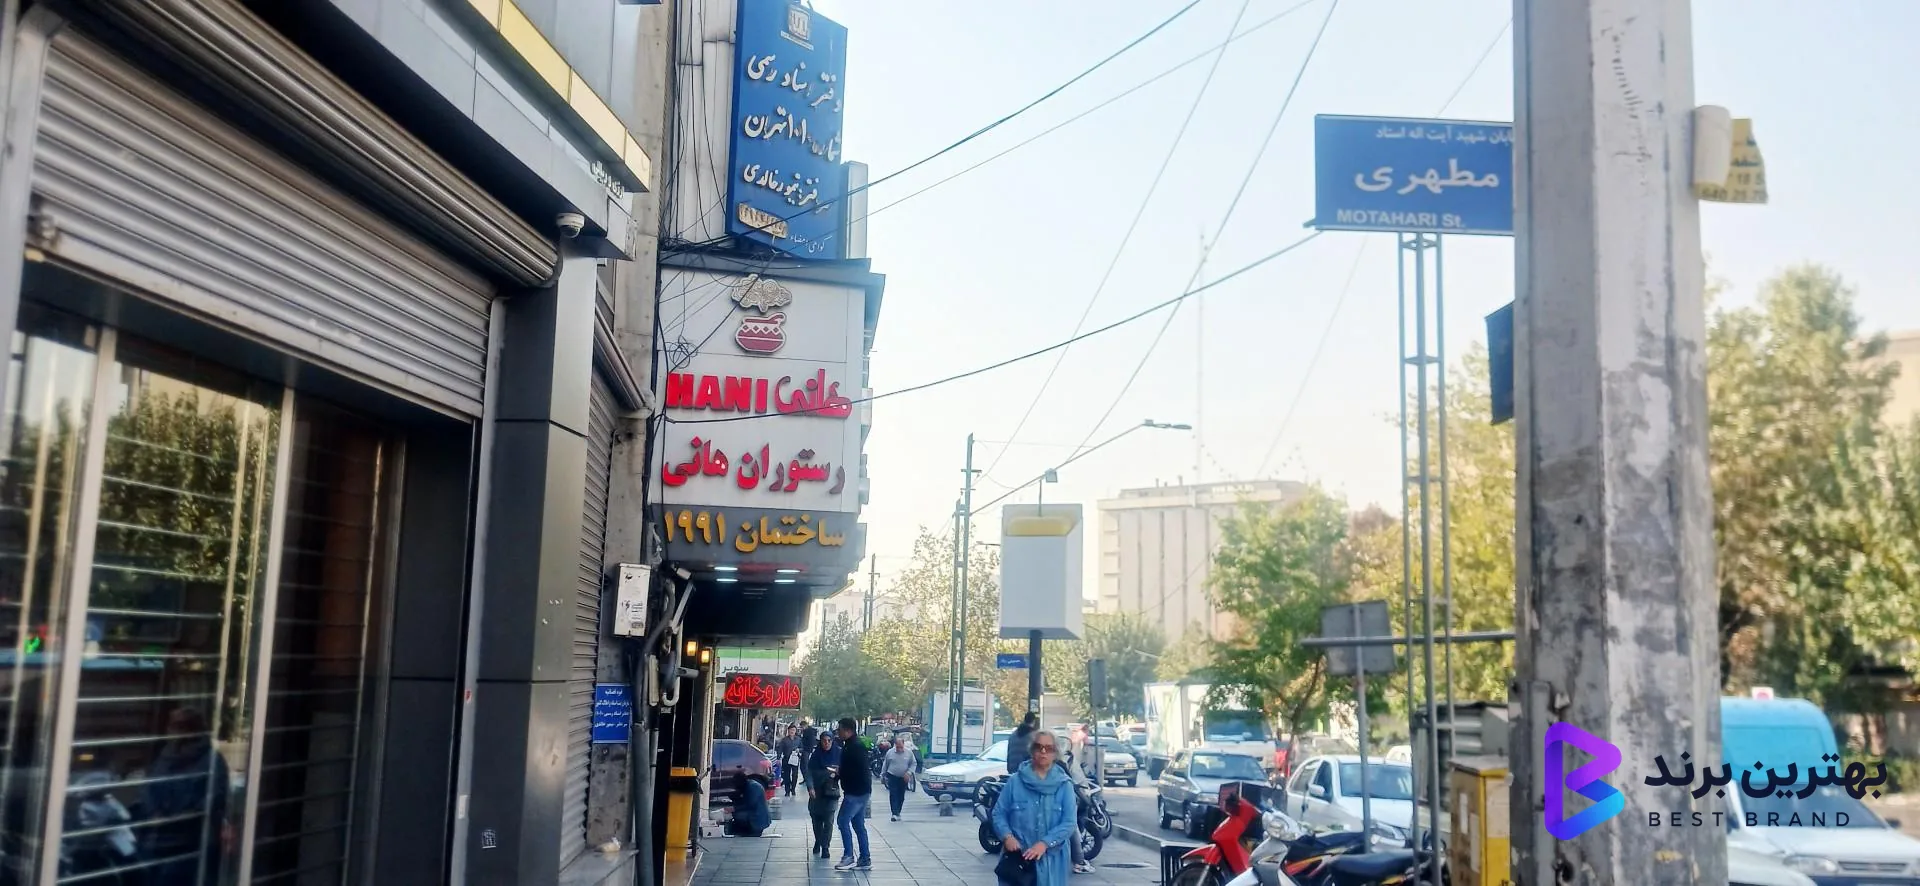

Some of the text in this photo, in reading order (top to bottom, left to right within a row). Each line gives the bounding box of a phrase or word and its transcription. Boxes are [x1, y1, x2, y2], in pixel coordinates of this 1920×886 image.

[747, 54, 777, 82] رسمی
[744, 105, 788, 139] تهران
[1375, 124, 1405, 139] استاد
[1354, 157, 1499, 194] مطهری
[1336, 208, 1466, 228] MOTAHARI St.
[666, 372, 769, 413] HANI
[775, 368, 853, 419] هانی
[662, 436, 847, 494] رستوران هانی
[664, 509, 847, 552] ساختمان ۱۹۹۱
[726, 676, 801, 707] داروخانه
